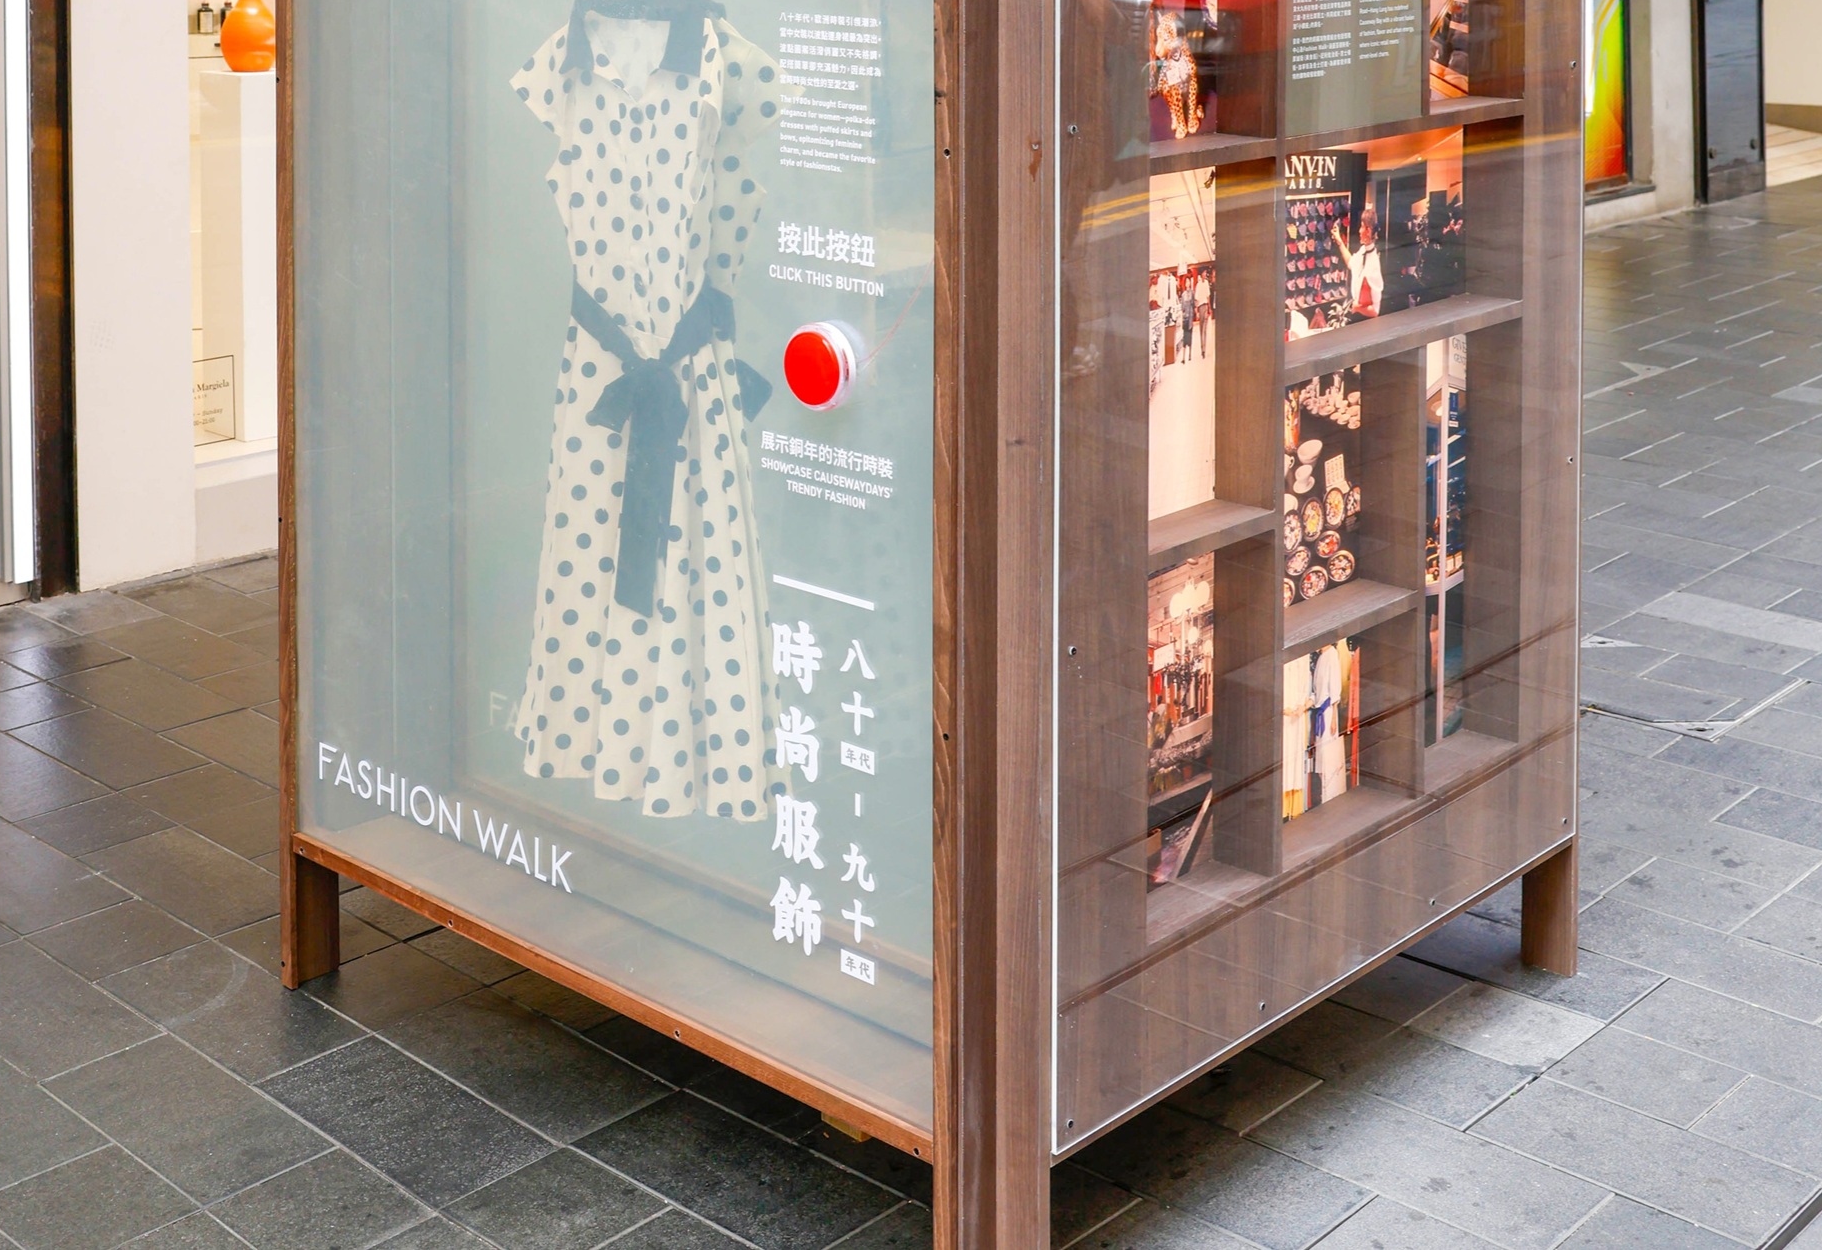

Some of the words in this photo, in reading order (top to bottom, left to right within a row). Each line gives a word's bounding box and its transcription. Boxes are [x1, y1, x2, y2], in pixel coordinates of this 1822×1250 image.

[780, 94, 792, 104] The
[811, 97, 836, 110] brought
[837, 100, 867, 112] European
[780, 108, 807, 119] elegance
[808, 110, 817, 119] for
[780, 121, 804, 130] dresses
[805, 122, 818, 132] with
[819, 124, 839, 135] puffed
[840, 126, 859, 137] skirts
[860, 129, 873, 139] and
[780, 157, 795, 168] style
[777, 221, 876, 269] 按此按鈕
[768, 264, 803, 284] CLICK
[805, 270, 833, 289] THIS
[835, 275, 884, 298] BUTTON
[760, 430, 894, 480] 展示銅年的流行時裝
[760, 456, 813, 480] SHOWCASE
[786, 479, 822, 501] TRENDY
[824, 487, 867, 511] FASHION
[769, 620, 824, 957] 時尚服飾
[317, 741, 462, 843] FASHION
[473, 808, 573, 894] WALK
